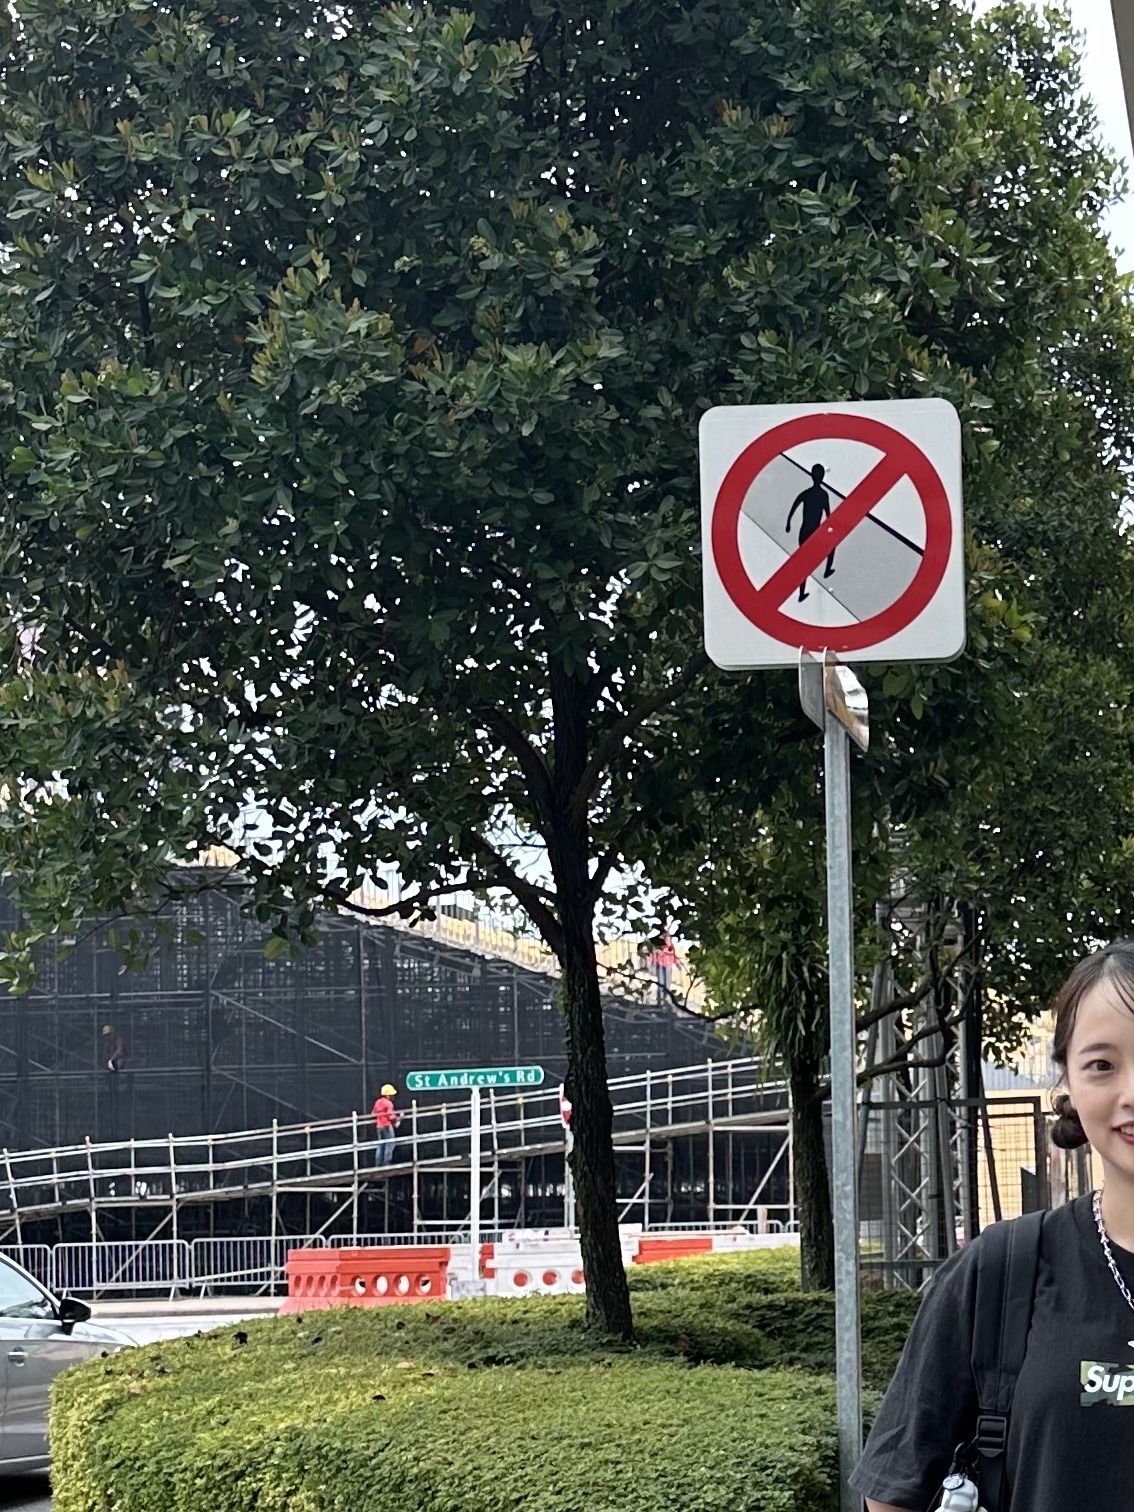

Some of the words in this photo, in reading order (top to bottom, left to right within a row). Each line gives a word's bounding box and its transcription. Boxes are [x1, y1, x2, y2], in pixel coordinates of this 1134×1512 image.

[414, 1073, 430, 1088] St
[437, 1071, 511, 1087] Andrew's
[516, 1069, 536, 1083] Rd
